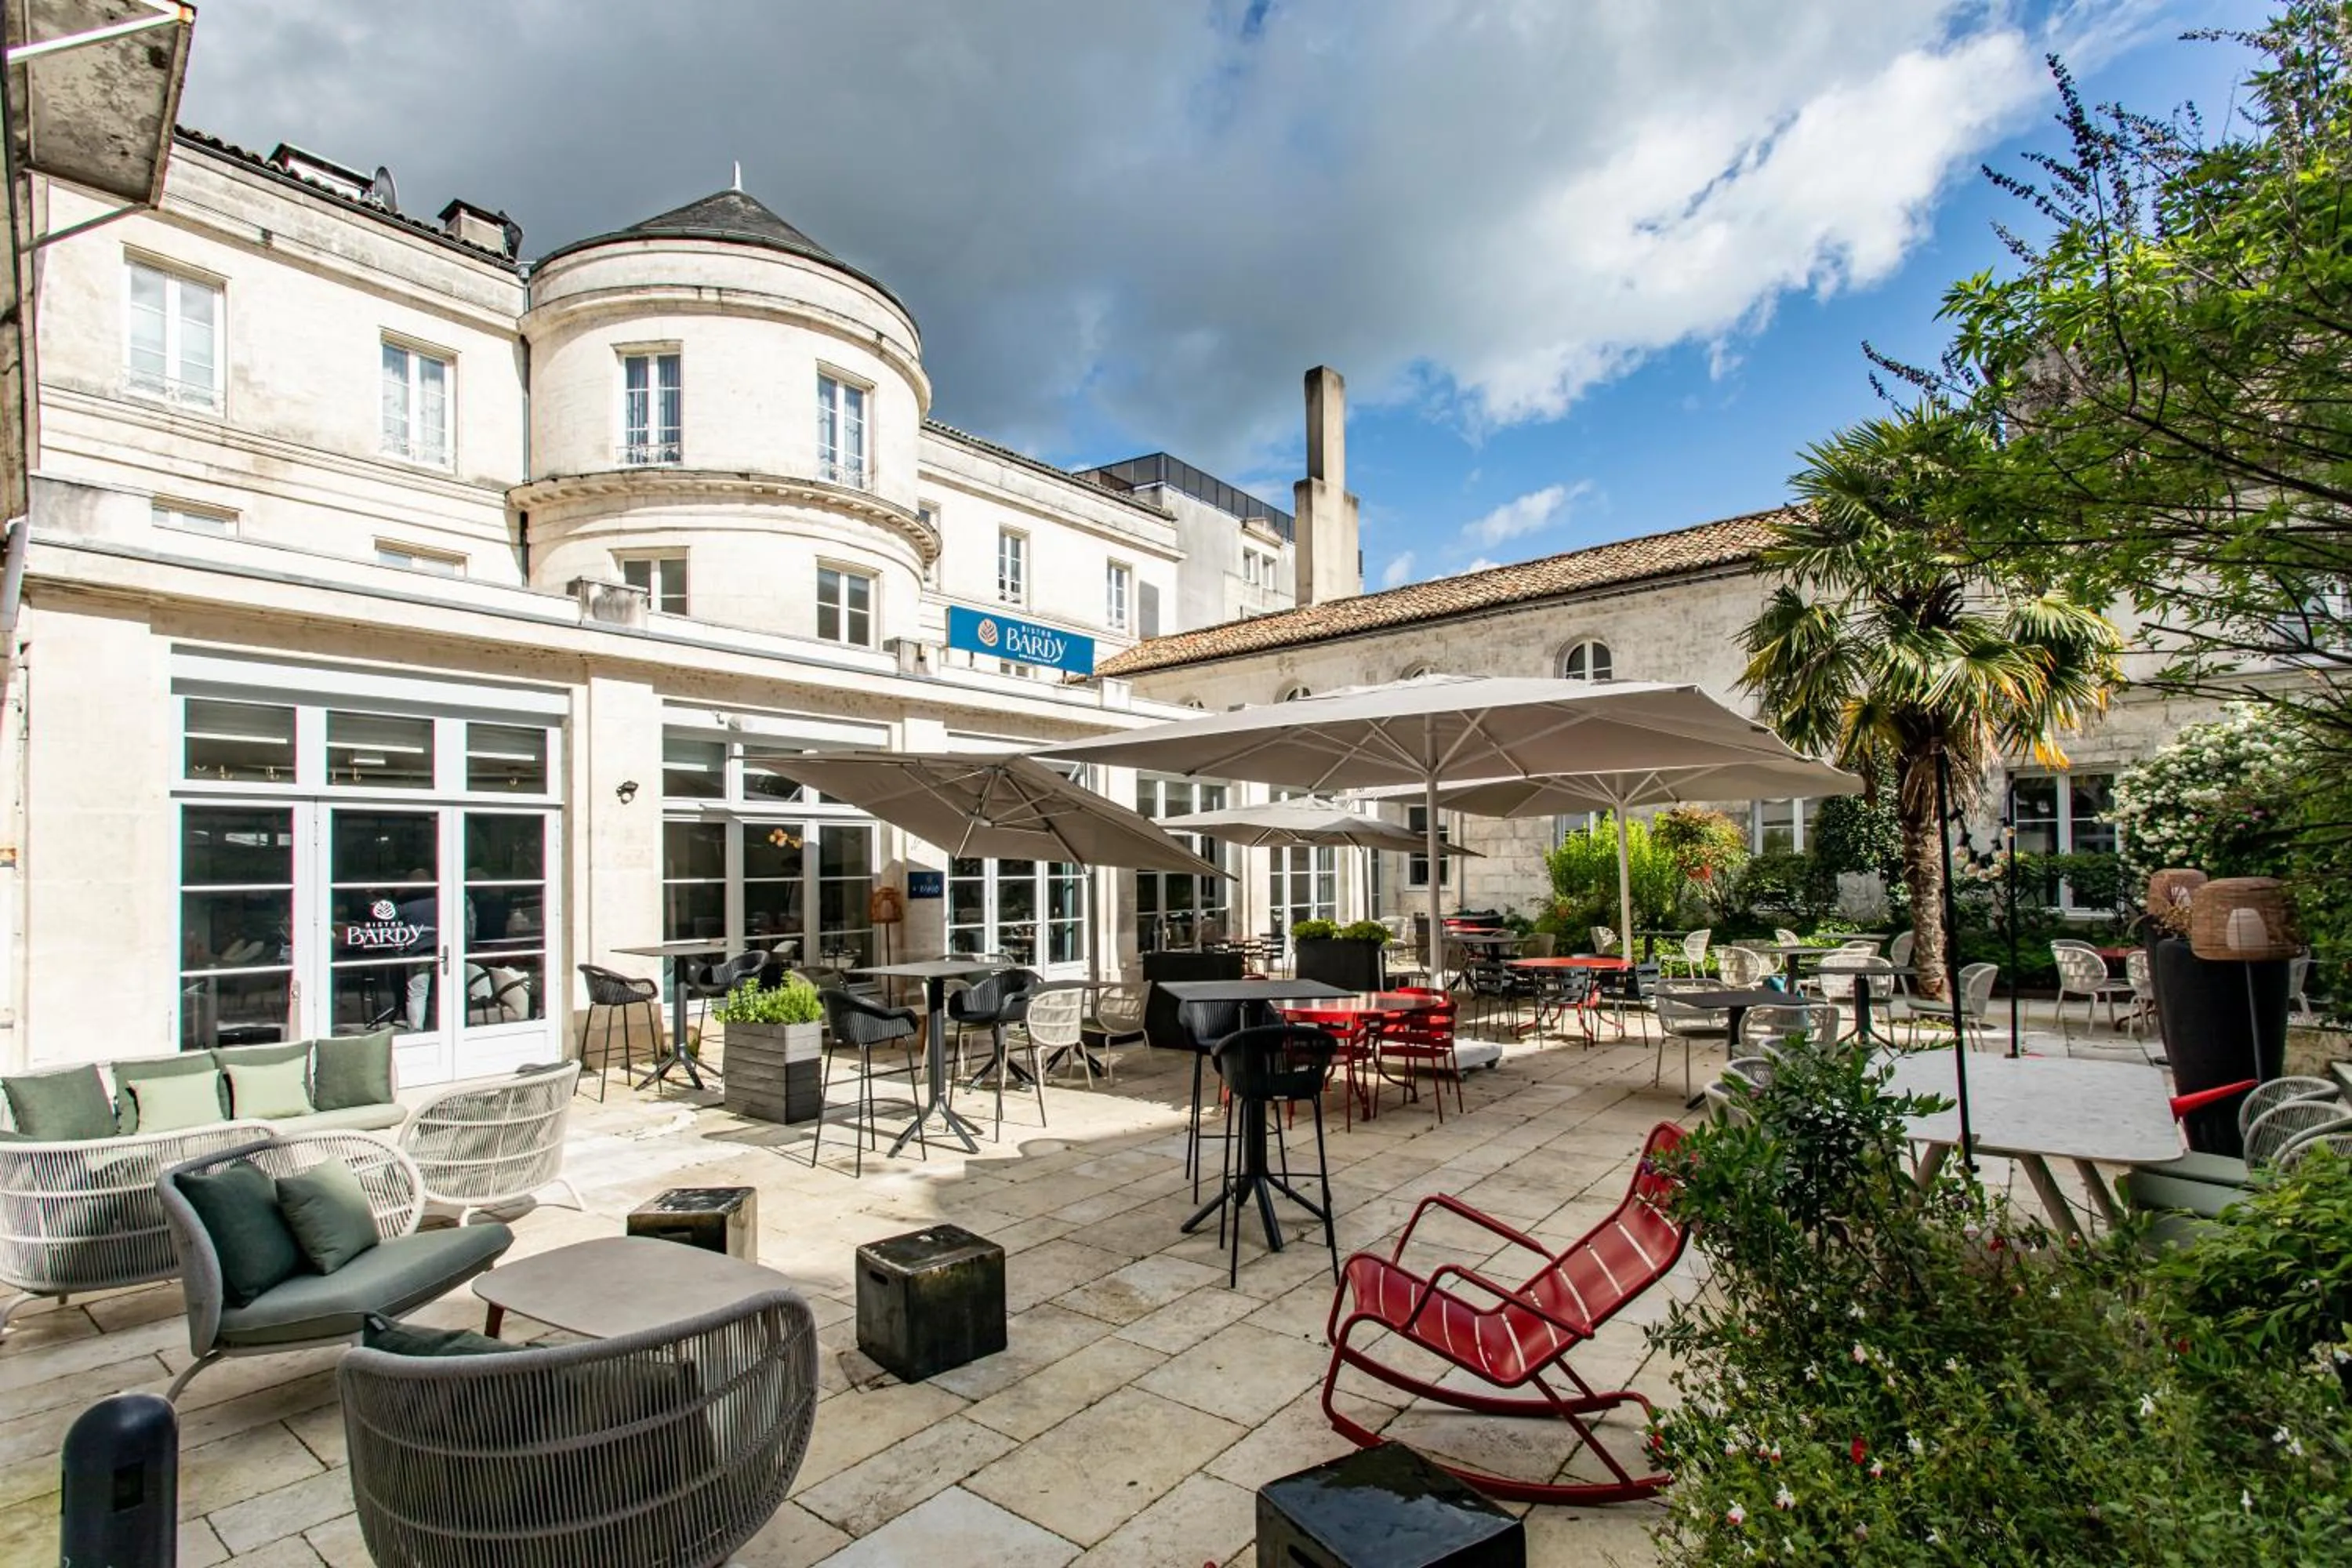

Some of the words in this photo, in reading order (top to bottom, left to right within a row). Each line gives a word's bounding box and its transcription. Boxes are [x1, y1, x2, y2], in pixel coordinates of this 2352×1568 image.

[1022, 625, 1051, 638] BISTRO
[1006, 627, 1067, 663] BARDY
[347, 924, 424, 946] BARDY
